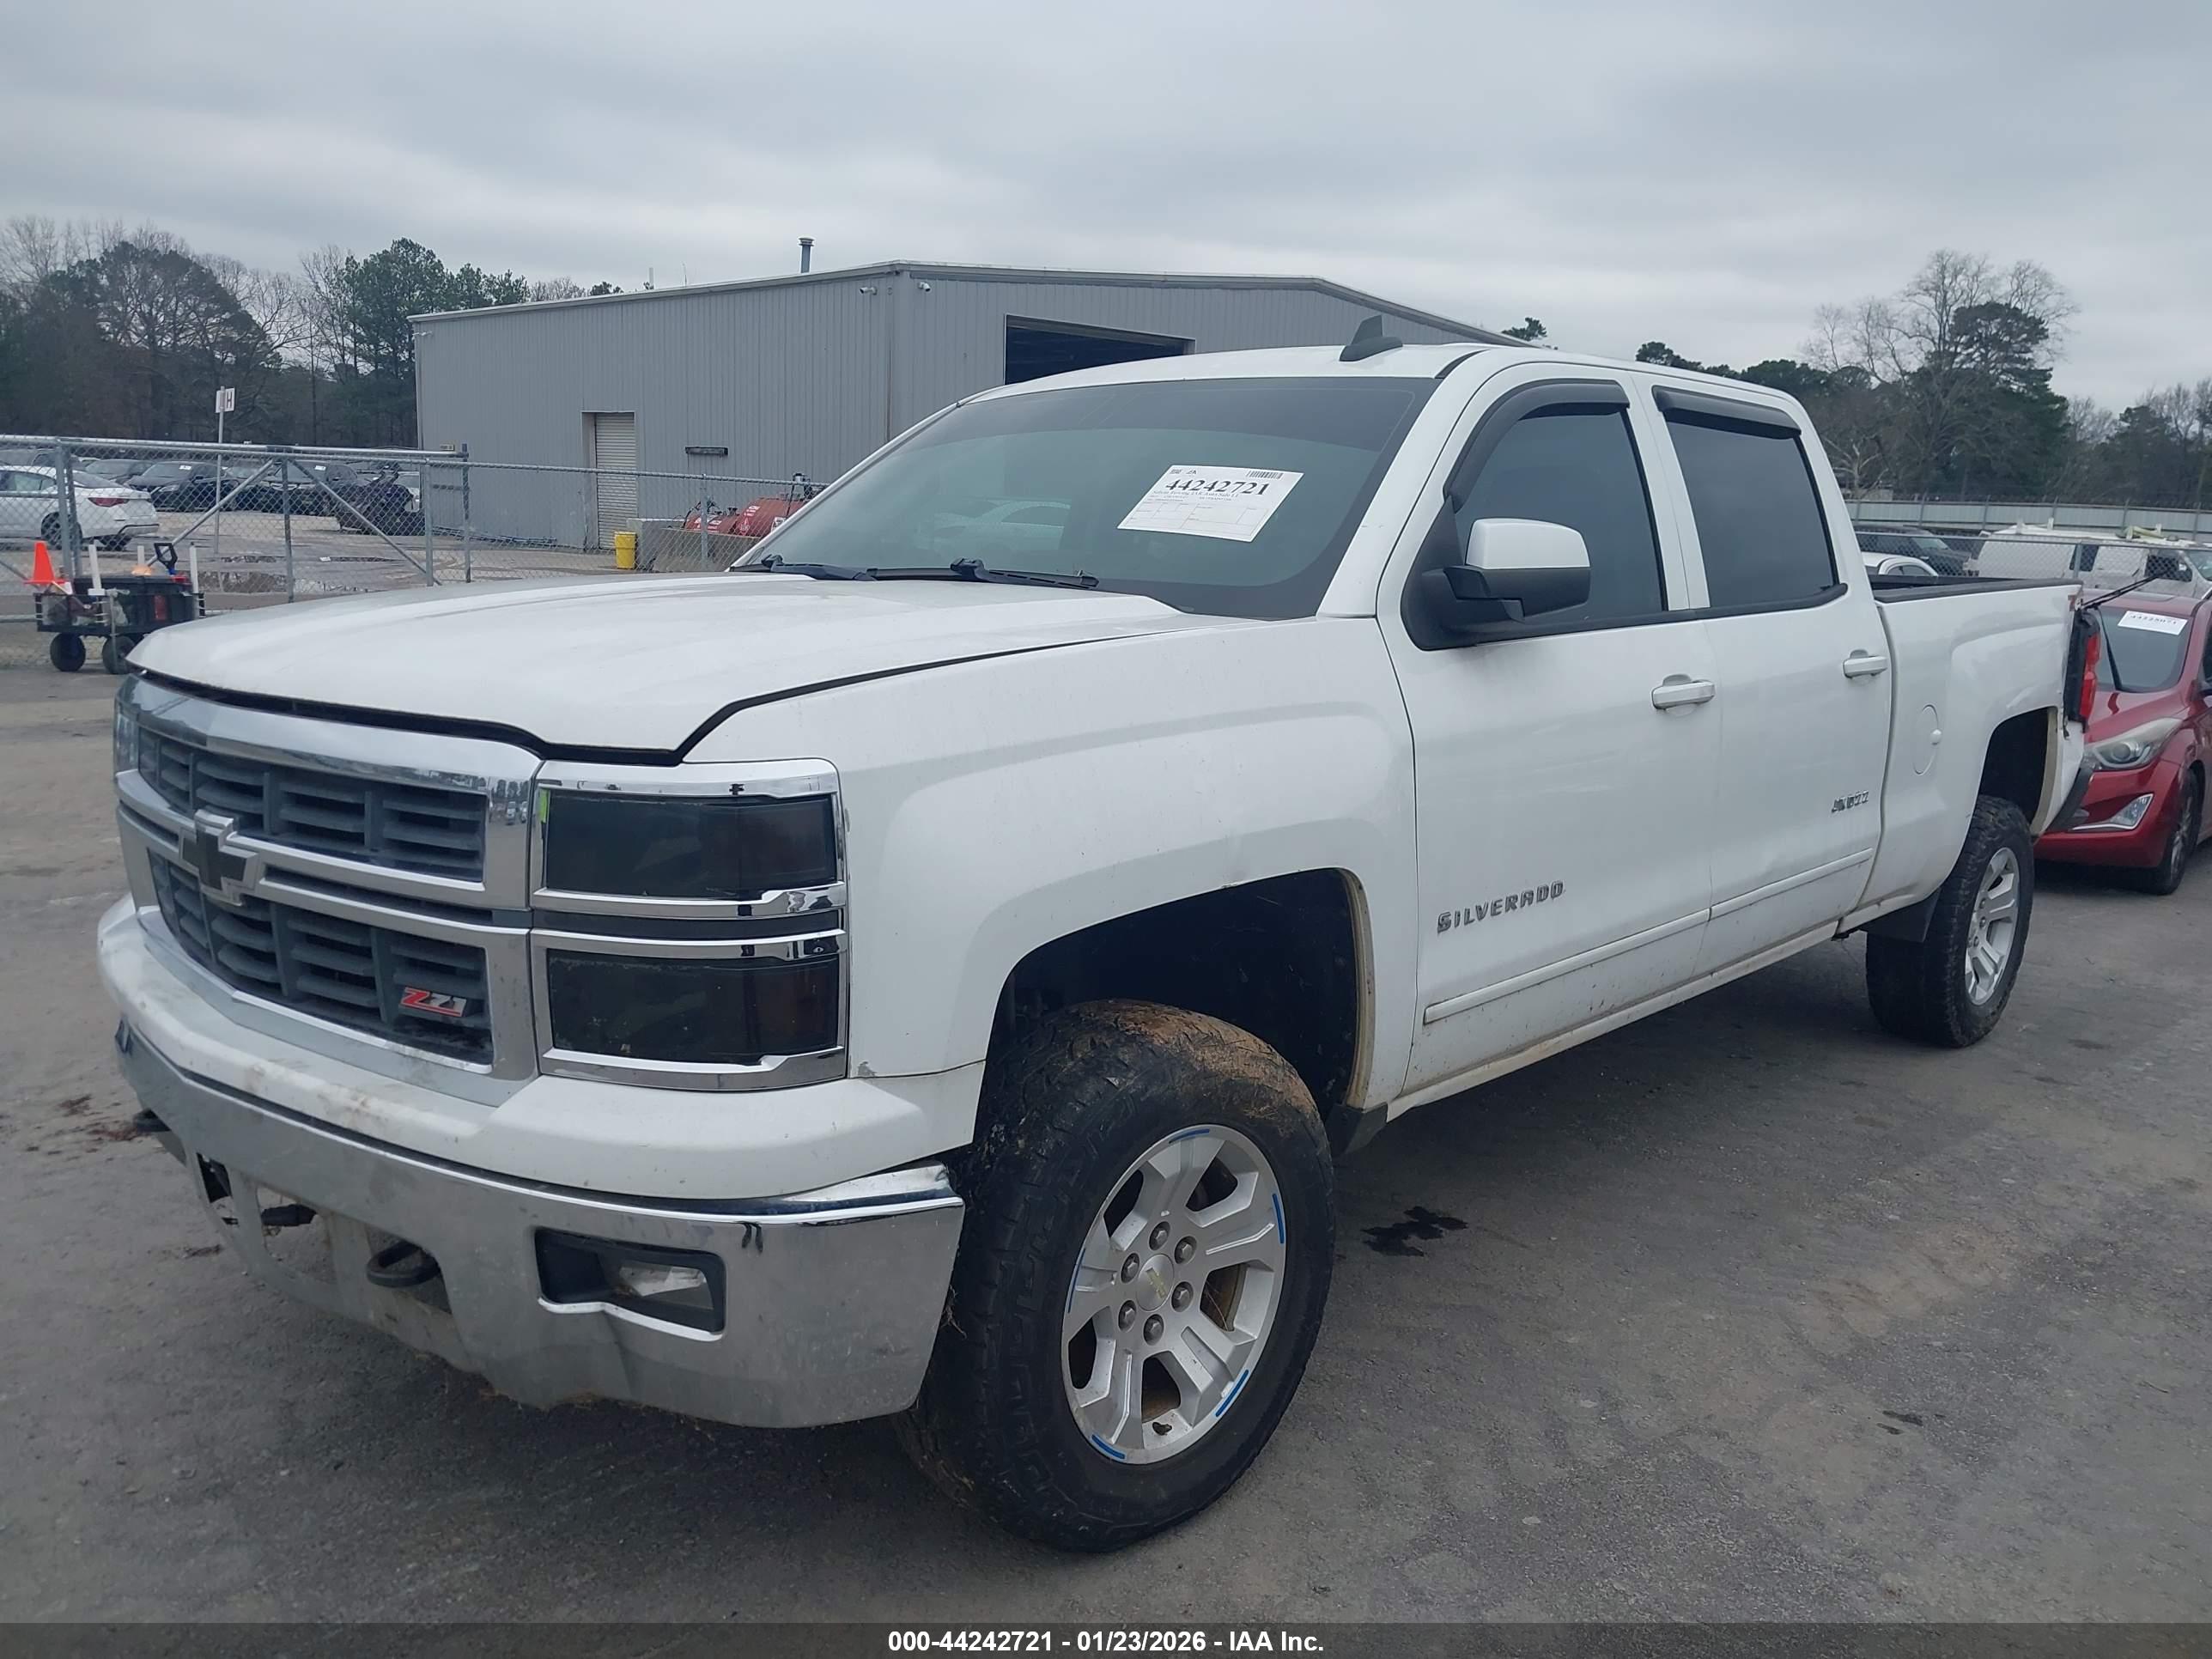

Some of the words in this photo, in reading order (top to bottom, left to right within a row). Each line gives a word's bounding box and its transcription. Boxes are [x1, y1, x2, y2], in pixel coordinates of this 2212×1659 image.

[226, 391, 233, 409] H
[1165, 479, 1271, 495] 44242721
[1437, 880, 1565, 933] SILVERADO
[400, 987, 467, 1017] Z71
